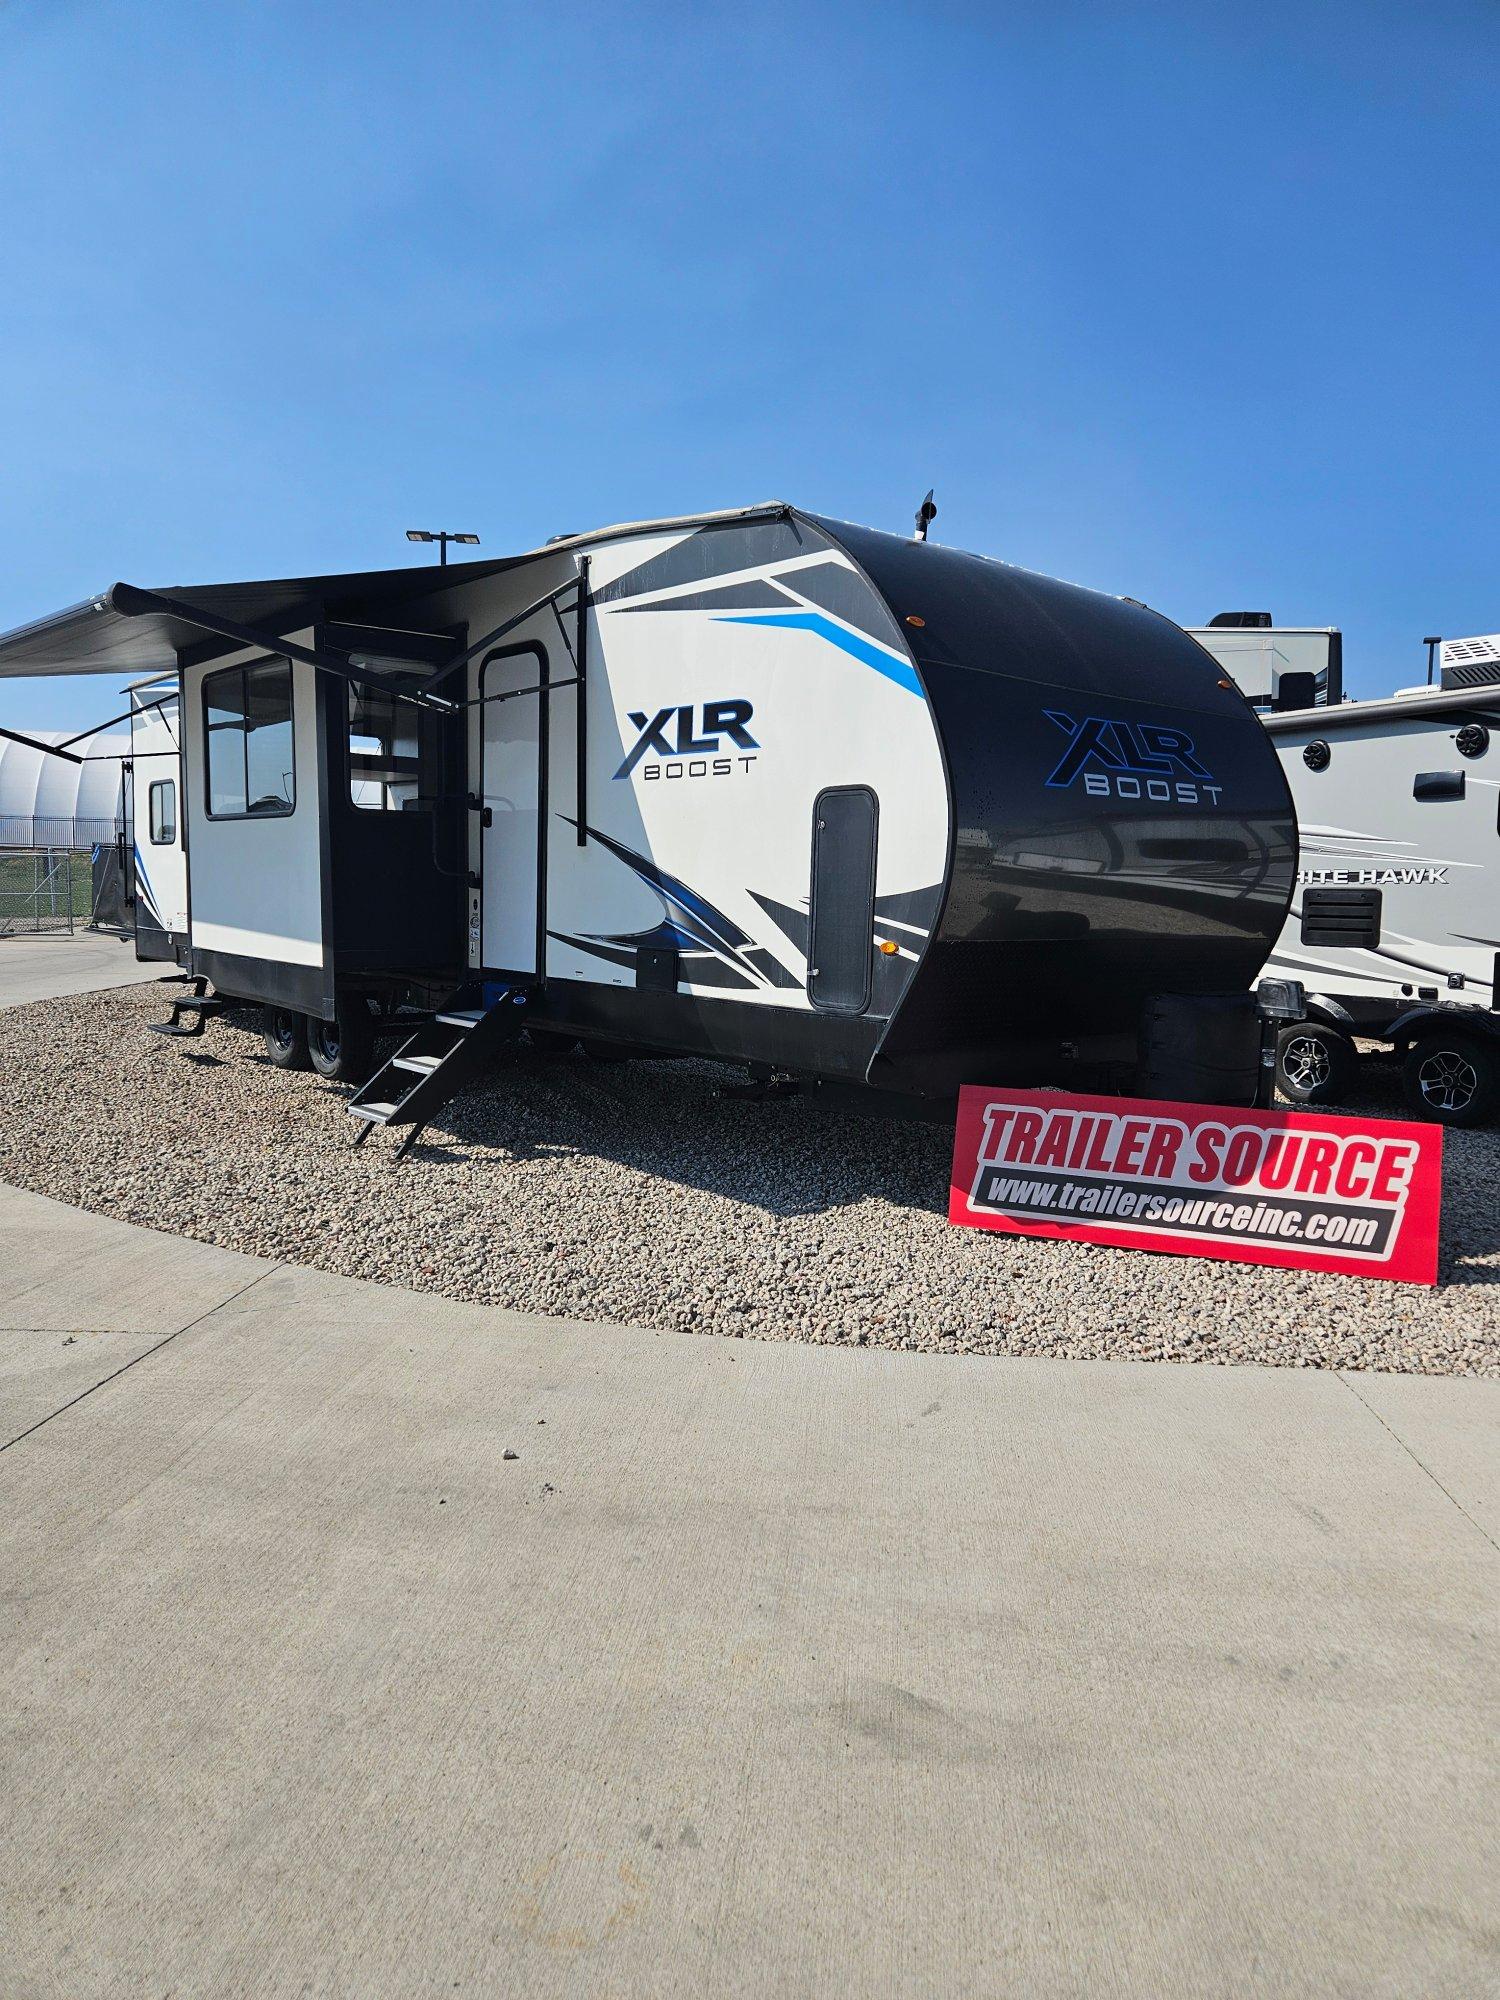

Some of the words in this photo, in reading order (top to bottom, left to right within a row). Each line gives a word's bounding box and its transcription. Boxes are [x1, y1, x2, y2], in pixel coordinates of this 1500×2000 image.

[611, 699, 762, 780] XLR
[644, 756, 757, 780] BOOST
[1042, 709, 1214, 788] XLR
[1084, 773, 1223, 805] BOOST
[1297, 869, 1348, 884] HITE
[1359, 867, 1450, 885] HAWK
[983, 1109, 1184, 1179] TRAILER
[1188, 1127, 1412, 1203] SOURCE
[987, 1177, 1379, 1246] www.trailersourceinc.com
